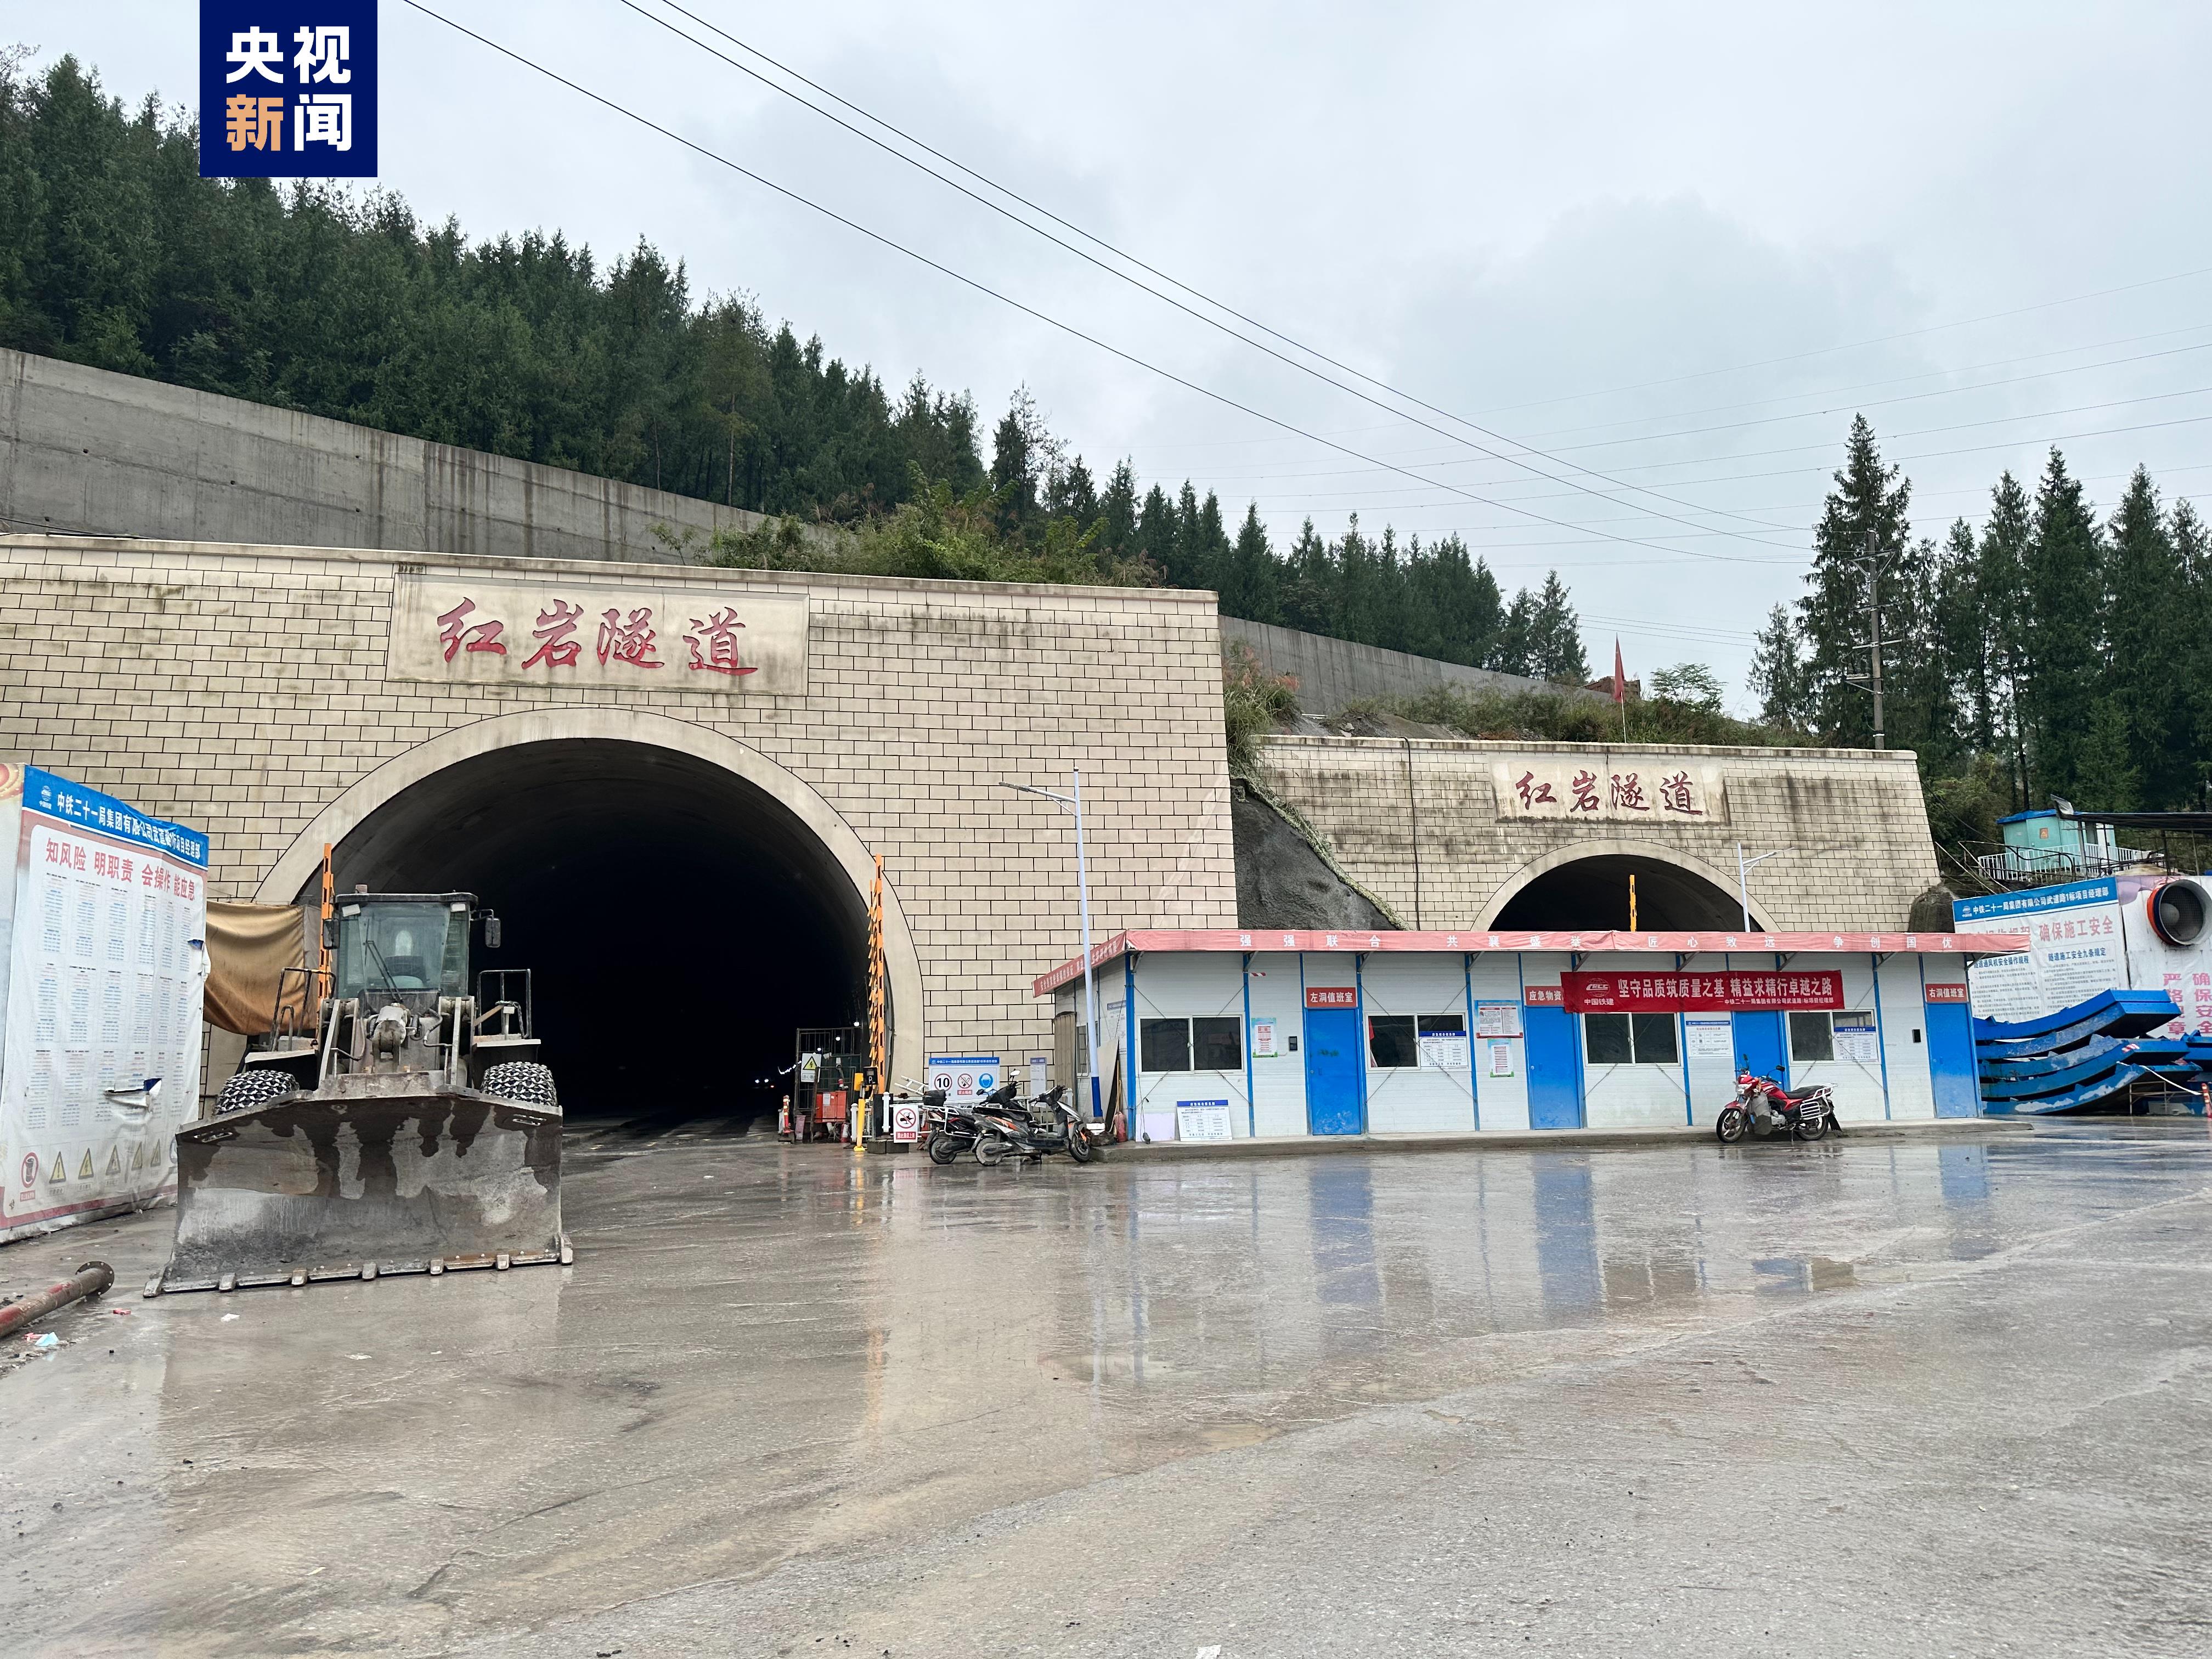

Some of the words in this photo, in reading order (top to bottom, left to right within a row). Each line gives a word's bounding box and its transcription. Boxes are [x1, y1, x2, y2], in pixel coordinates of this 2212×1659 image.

[437, 596, 758, 675] 红岩隧道
[1515, 769, 1703, 816] 红岩隧道
[45, 837, 86, 871] 知风险
[94, 851, 133, 883] 明职责
[142, 864, 171, 893] 会操作
[173, 873, 195, 901] 能应急
[2039, 915, 2114, 942] 确保施工安全
[1239, 934, 1381, 948] 强强联合
[1446, 935, 1582, 948] 共襄盛举
[1647, 936, 1776, 949] 匠心致远
[1832, 936, 1953, 949] 争创国优
[2048, 947, 2107, 962] 隧道施工安全九条规定
[1618, 978, 1724, 998] 坚守品质筑质量之基
[1730, 977, 1832, 997] 精益求精行卓越之路
[1929, 987, 1965, 998] 右洞值班室
[1310, 991, 1353, 1003] 左洞值班室
[1529, 990, 1564, 1001] 应急物资
[936, 1077, 950, 1088] 10
